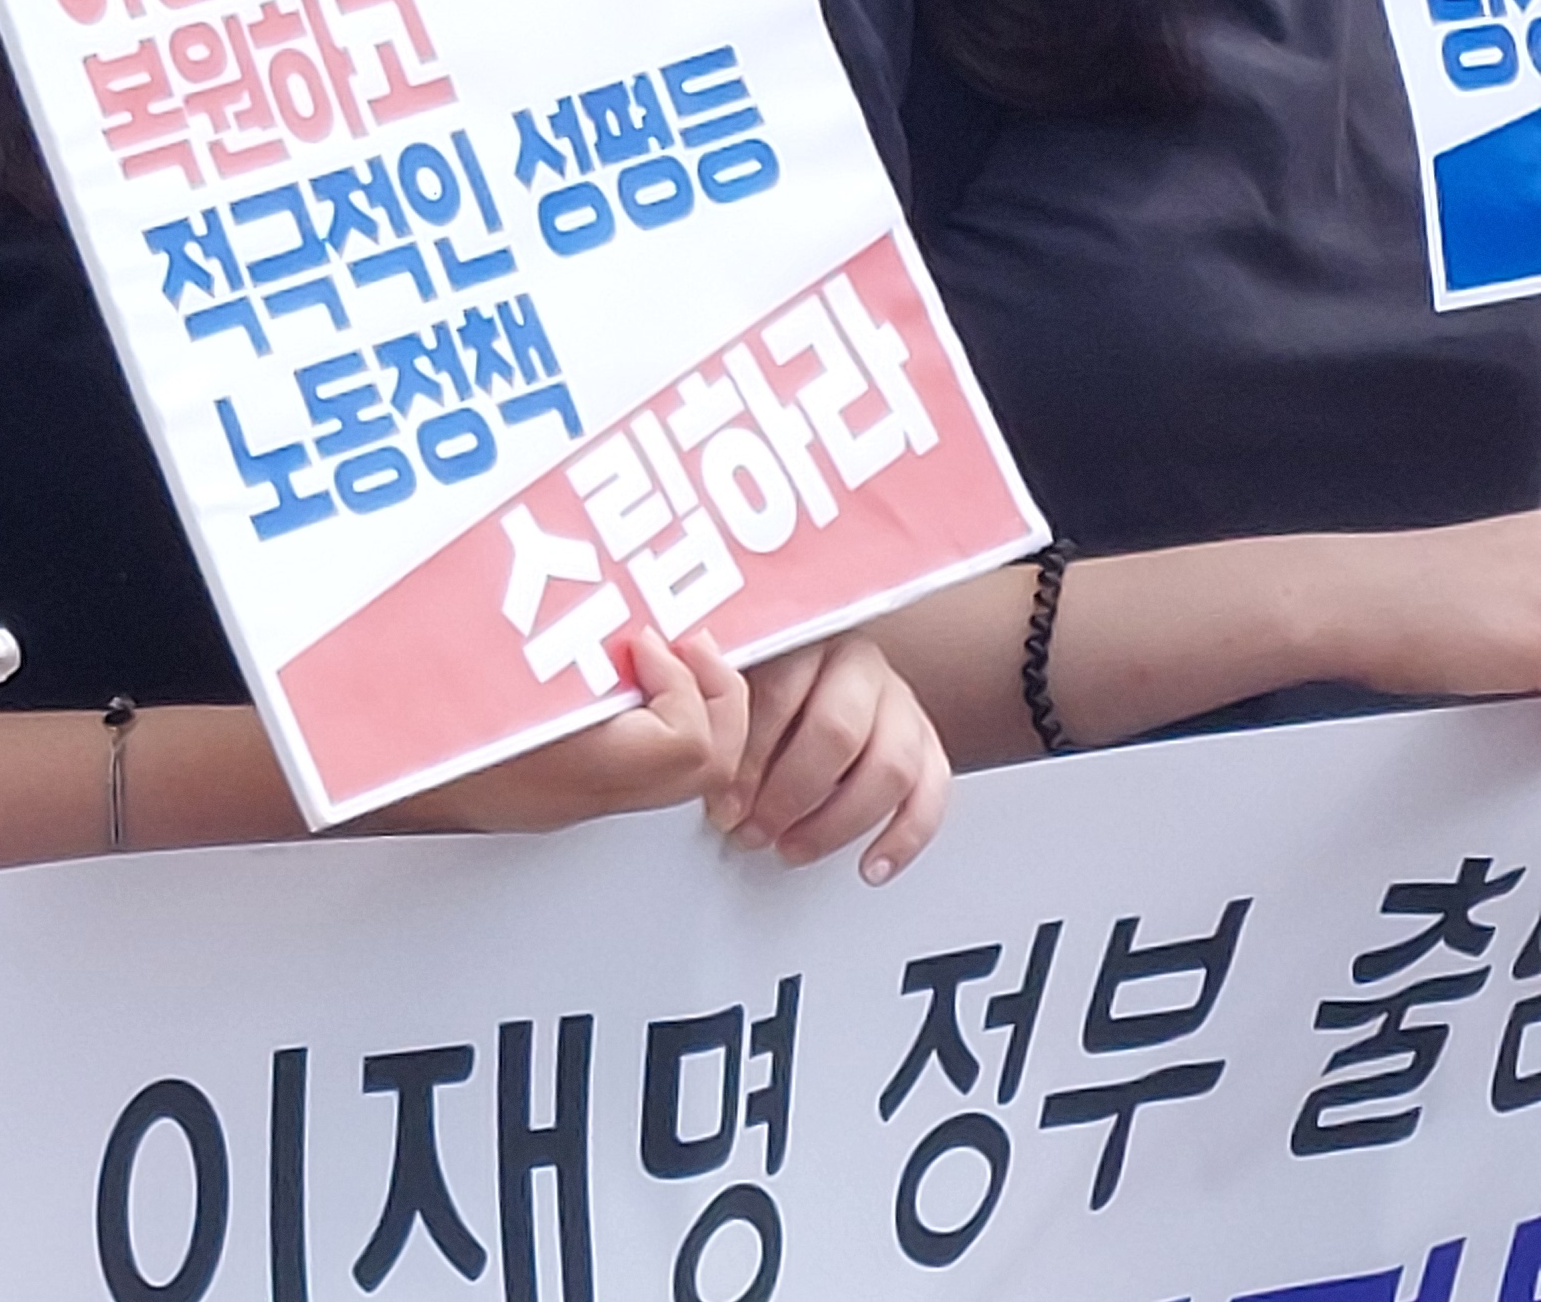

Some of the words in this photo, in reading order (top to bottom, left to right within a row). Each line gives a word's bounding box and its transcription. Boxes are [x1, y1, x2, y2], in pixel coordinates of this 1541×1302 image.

[145, 129, 518, 356] 적극적인
[513, 44, 781, 258] 성평등
[215, 293, 583, 541] 노동정책
[499, 273, 939, 697] 수립하라
[95, 971, 804, 1302] 이재명
[878, 896, 1255, 1268] 정부
